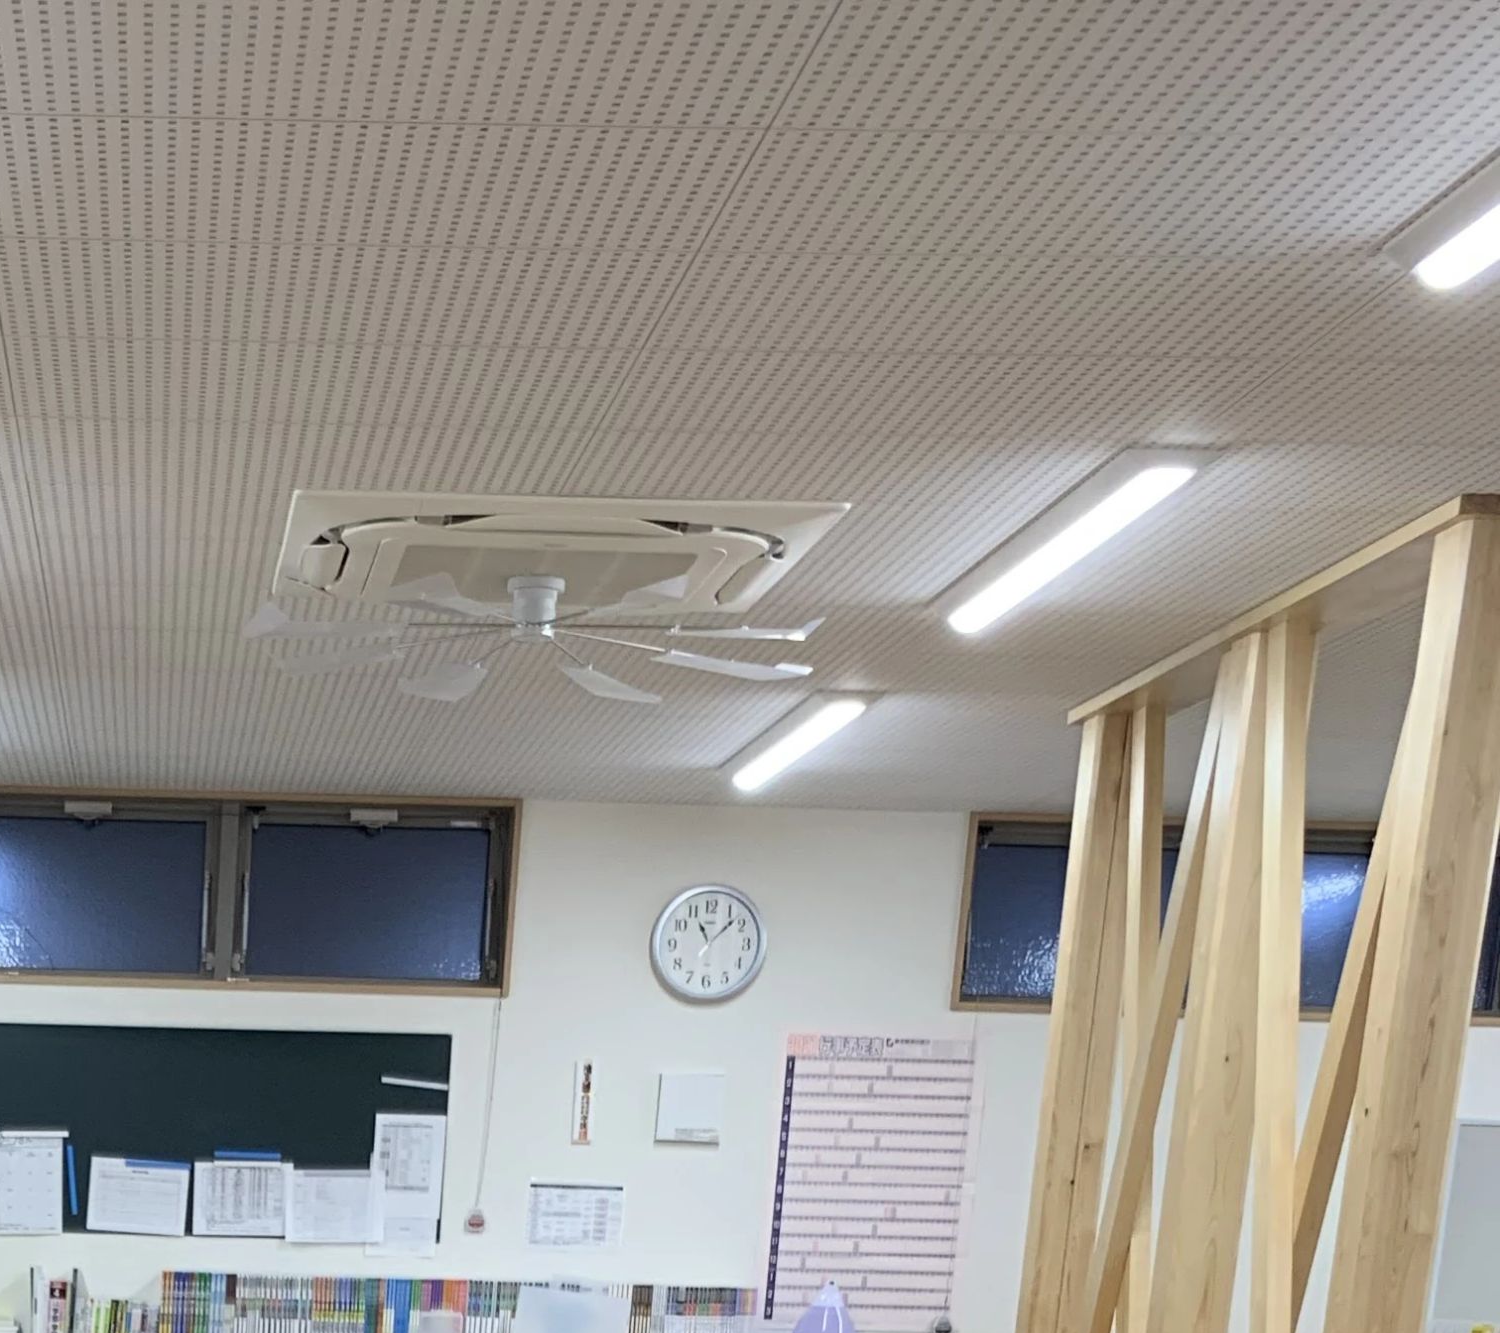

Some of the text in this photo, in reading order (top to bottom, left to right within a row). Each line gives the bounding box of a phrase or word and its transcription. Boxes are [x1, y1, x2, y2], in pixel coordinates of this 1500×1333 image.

[689, 905, 698, 918] 11
[706, 899, 718, 914] 12
[728, 904, 732, 918] 1
[675, 919, 687, 932] 10
[738, 919, 746, 932] 2
[668, 938, 677, 952] 9
[742, 937, 750, 951] 3
[673, 958, 682, 970] 8
[686, 971, 694, 984] 7
[701, 975, 711, 989] 6
[720, 972, 729, 984] 5
